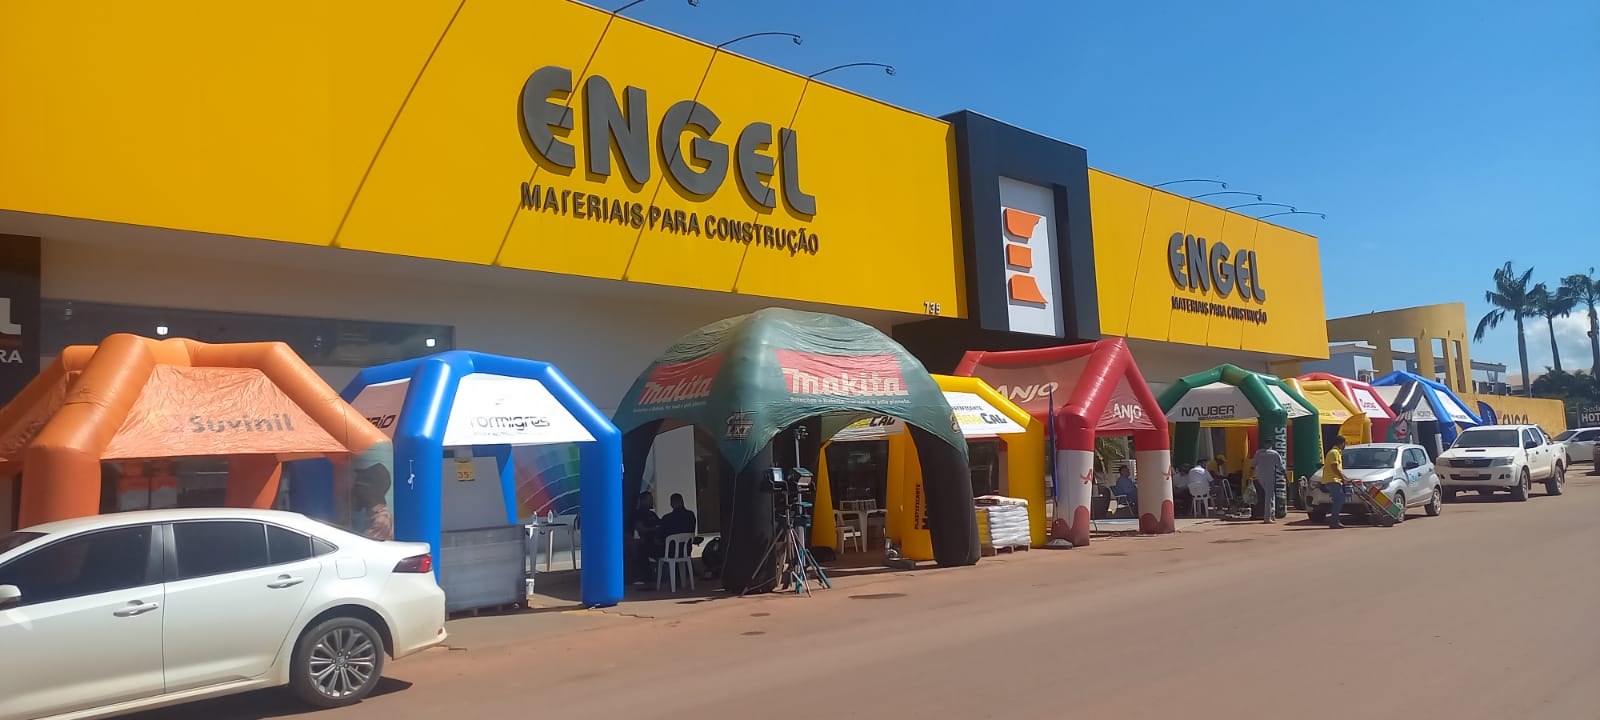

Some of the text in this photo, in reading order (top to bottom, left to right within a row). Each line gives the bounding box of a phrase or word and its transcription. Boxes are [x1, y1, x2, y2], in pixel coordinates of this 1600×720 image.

[519, 65, 817, 219] ENGEL
[520, 182, 820, 257] MATERIAIS PARA CONSTRUÇÃO
[1168, 232, 1266, 304] ENGEL
[1171, 296, 1209, 316] MATERIAIS
[1209, 303, 1227, 319] PARA
[1113, 403, 1142, 423] ANJO
[1181, 405, 1235, 417] NAUBER
[189, 413, 294, 433] Suvinil
